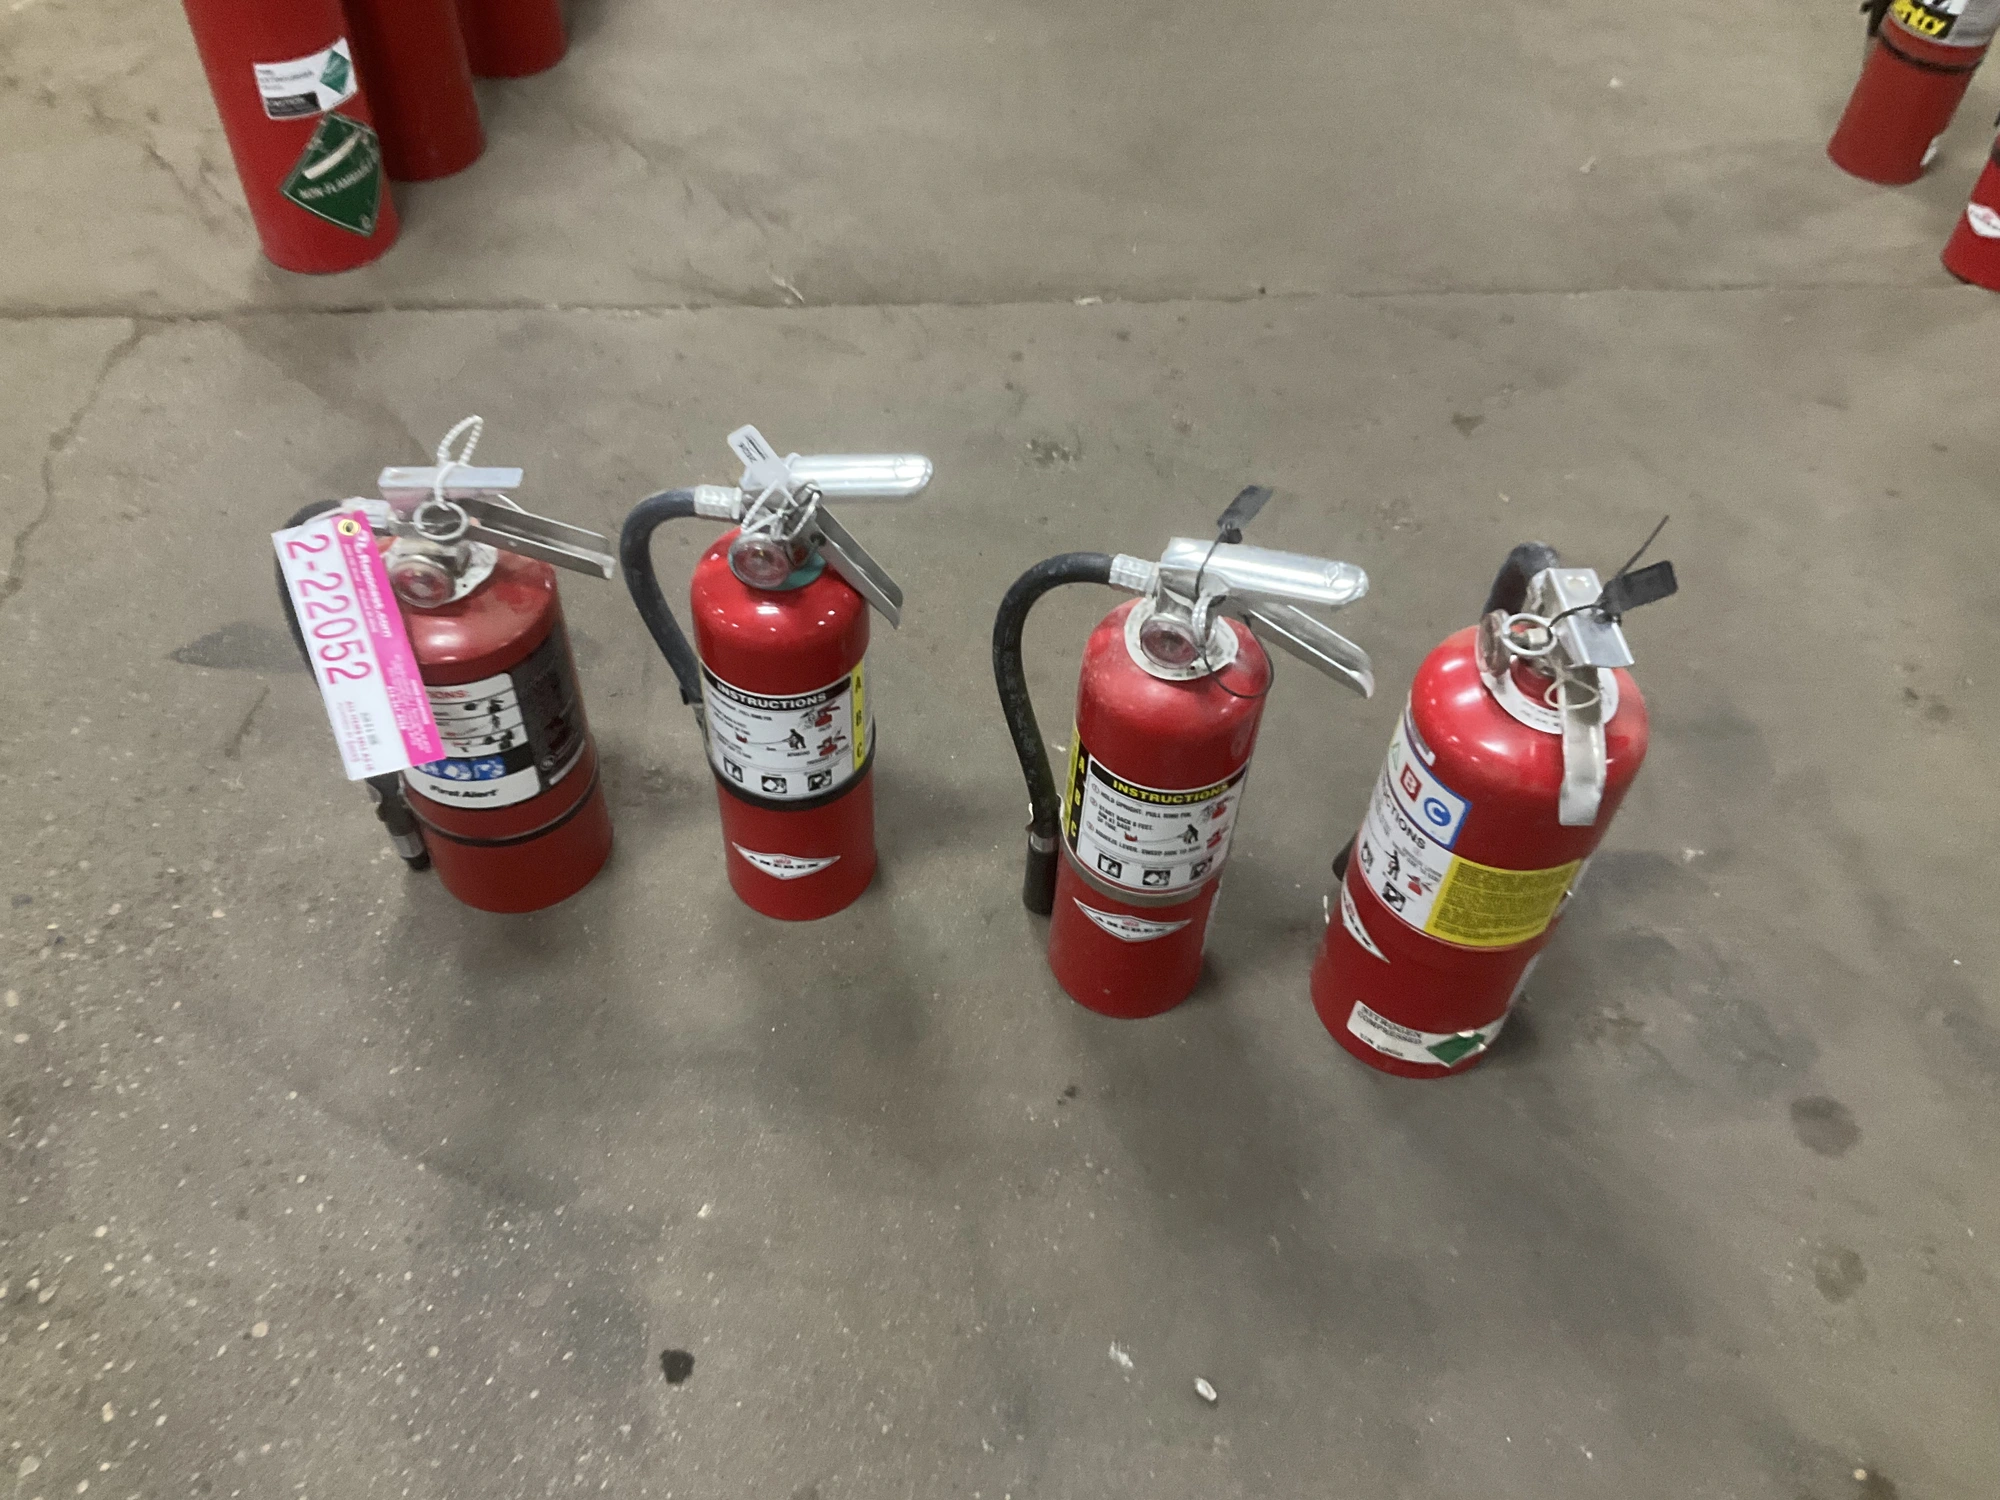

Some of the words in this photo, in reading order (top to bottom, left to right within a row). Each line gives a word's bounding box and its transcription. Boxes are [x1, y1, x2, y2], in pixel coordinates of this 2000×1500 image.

[286, 533, 372, 685] 2-22052
[716, 682, 827, 709] INSTRUCTIONS
[1112, 779, 1229, 804] INSTRUCTIONS
[1427, 802, 1446, 822] C
